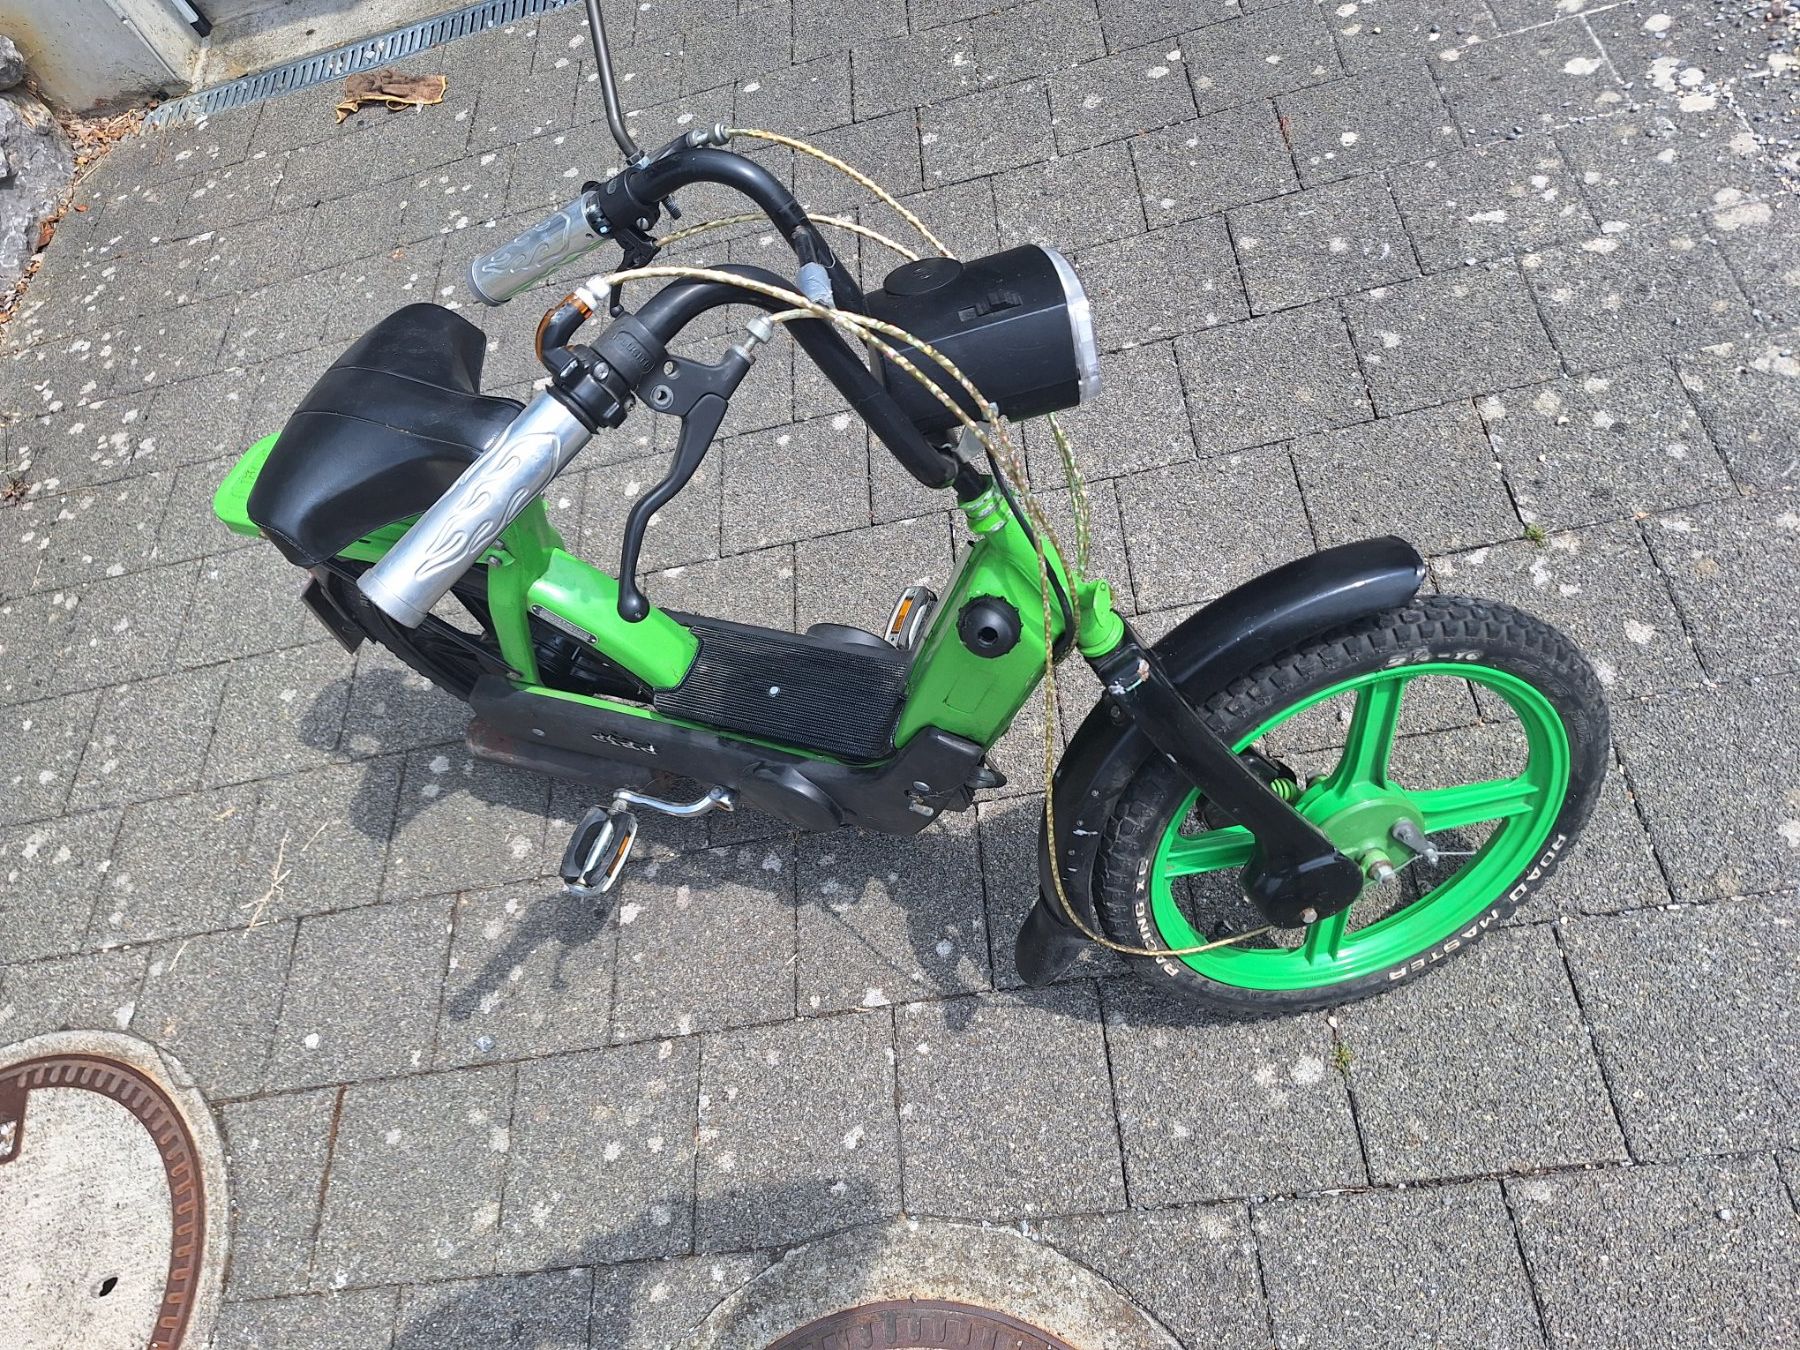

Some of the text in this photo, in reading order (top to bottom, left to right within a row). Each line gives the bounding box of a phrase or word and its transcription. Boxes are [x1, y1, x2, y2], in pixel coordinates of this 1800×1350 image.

[1133, 902, 1180, 977] RACING
[1388, 832, 1567, 981] ROAD MASTER
